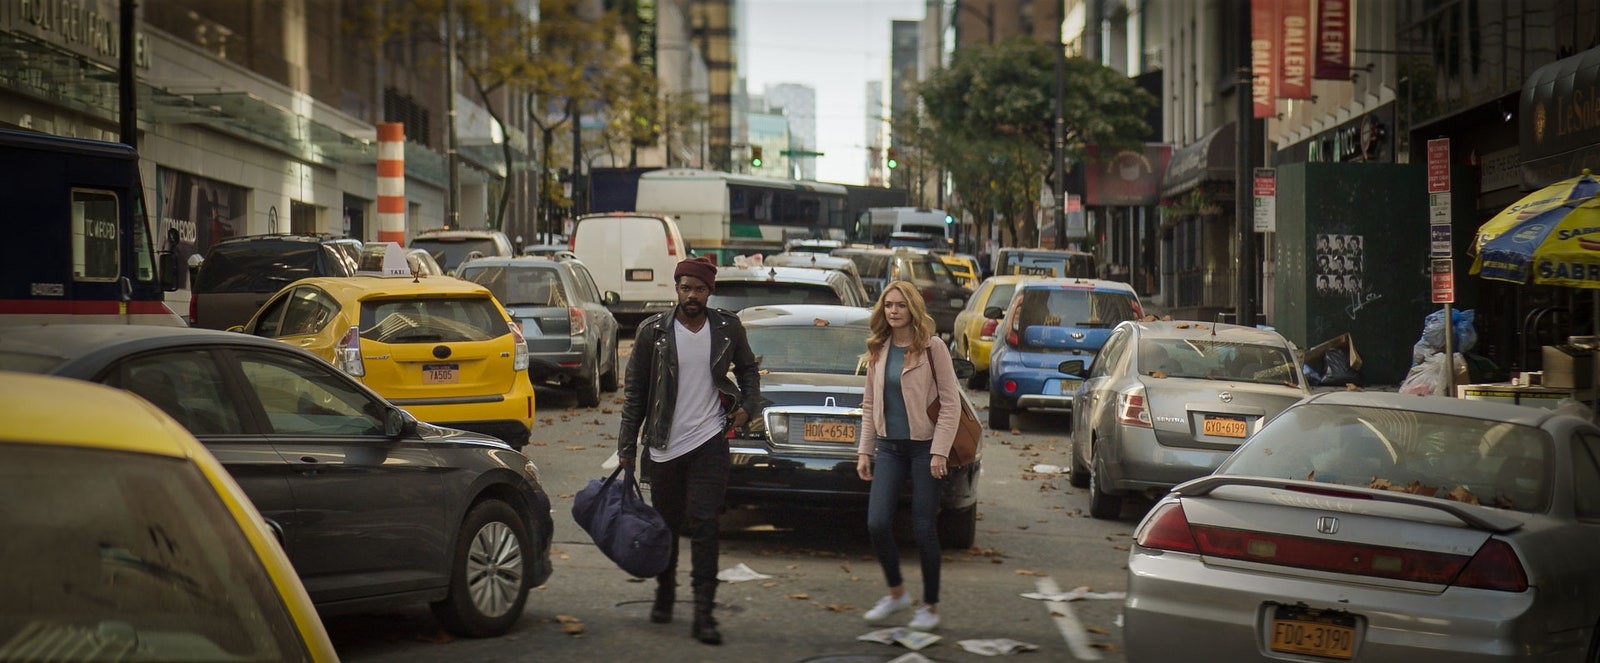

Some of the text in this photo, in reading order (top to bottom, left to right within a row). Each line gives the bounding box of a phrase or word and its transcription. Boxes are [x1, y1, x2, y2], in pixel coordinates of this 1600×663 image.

[1251, 39, 1272, 105] GALLERY
[1284, 16, 1306, 87] GALLERY
[429, 370, 453, 380] 7A505
